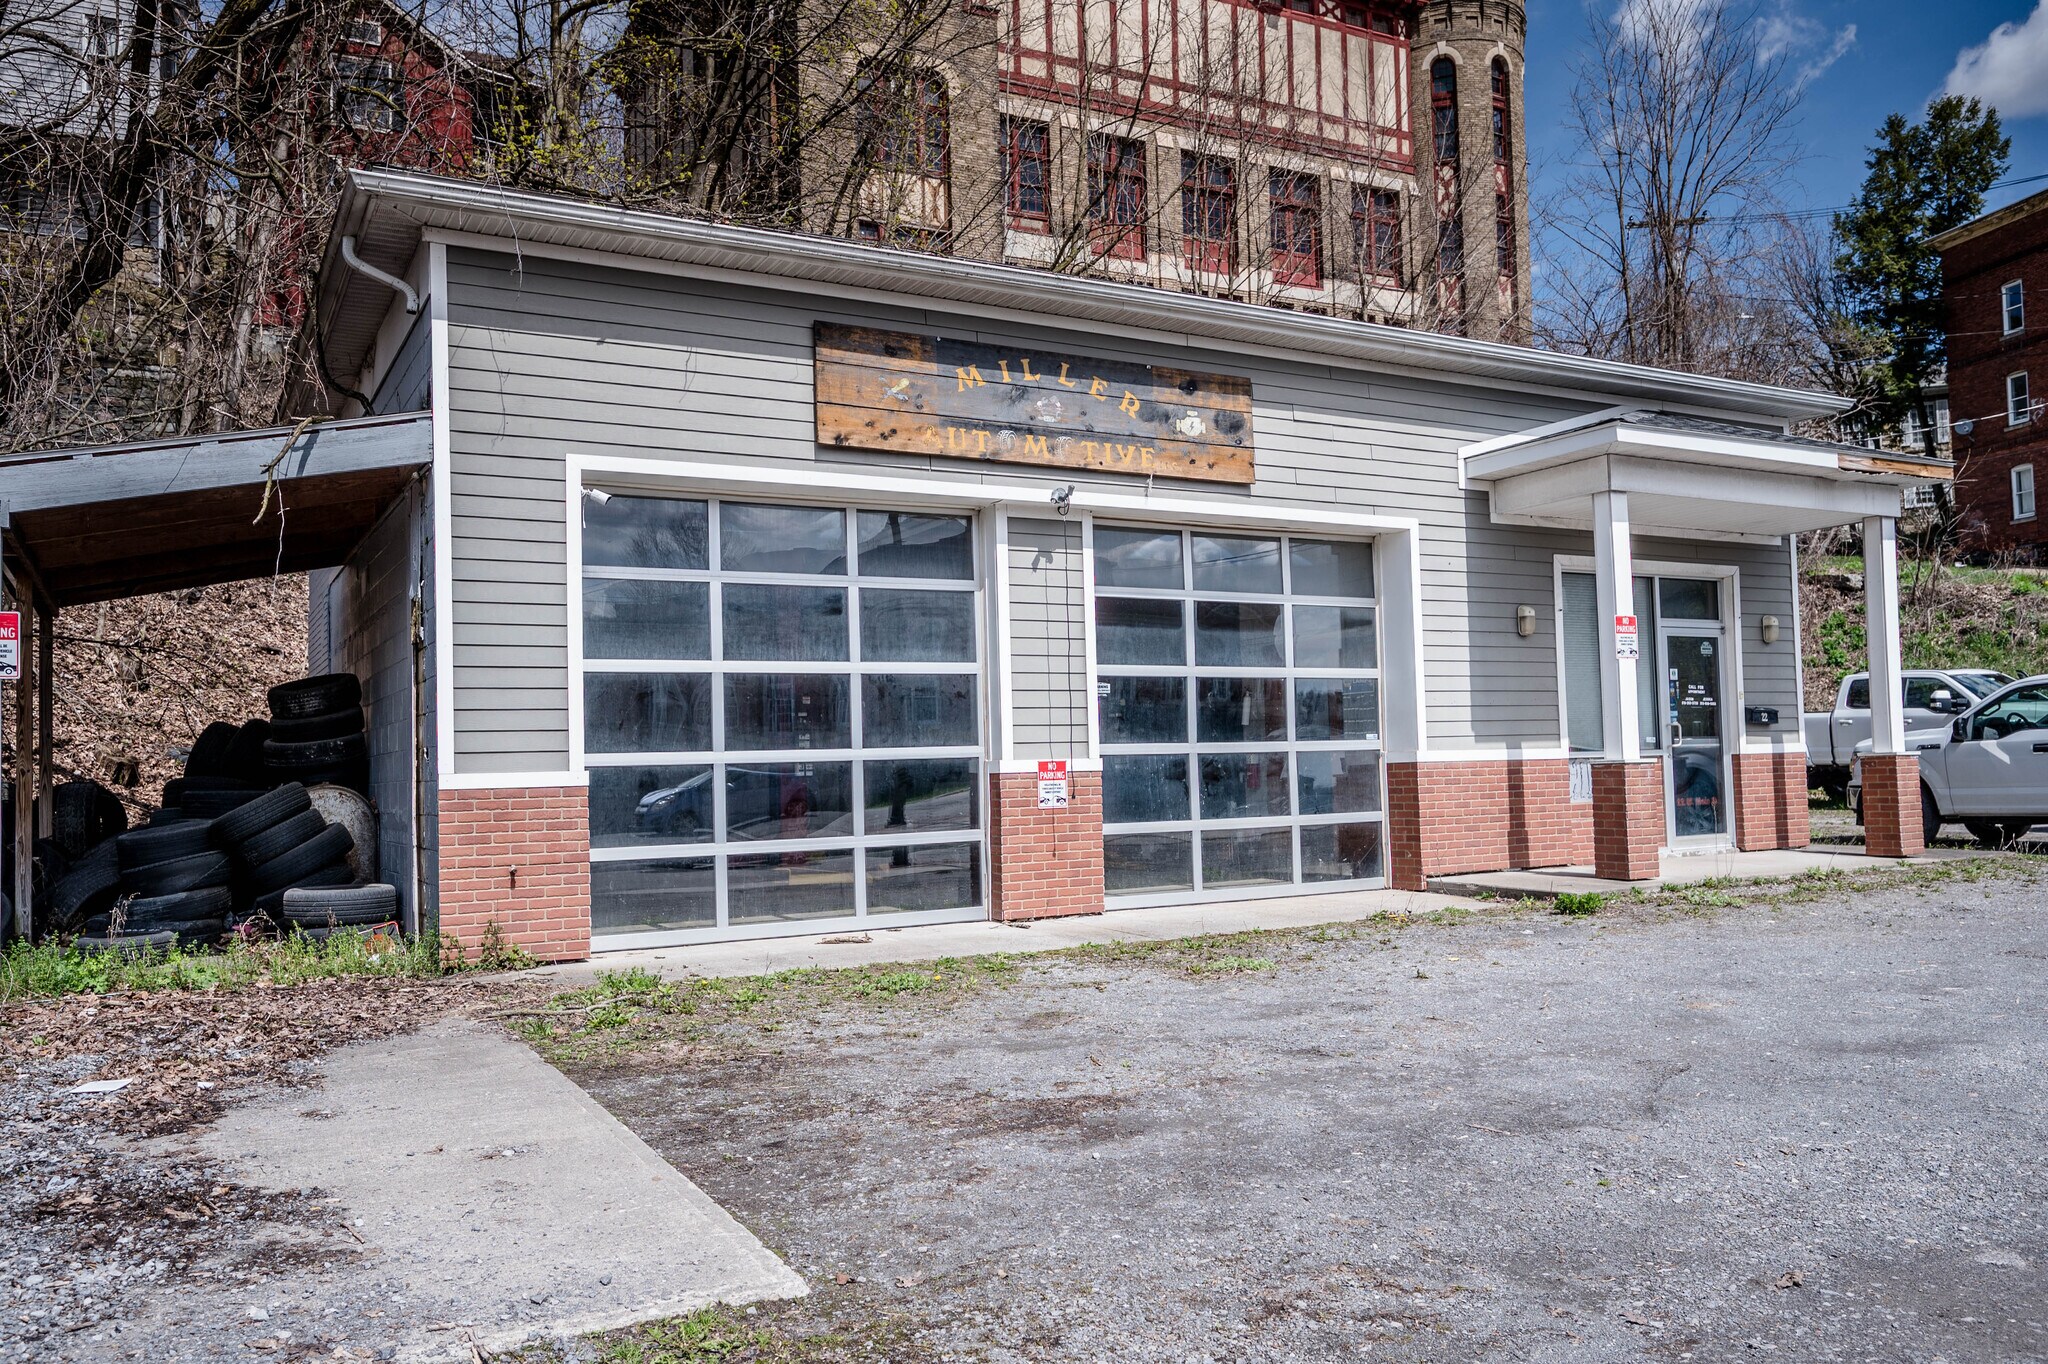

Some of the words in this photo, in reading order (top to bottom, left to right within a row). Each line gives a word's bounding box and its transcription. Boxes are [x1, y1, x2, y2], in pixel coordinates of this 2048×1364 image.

[955, 358, 1141, 419] MILLER
[1622, 617, 1630, 625] NO
[1616, 625, 1636, 633] PARKING
[1760, 712, 1769, 722] 22
[1047, 762, 1057, 771] NO
[1040, 771, 1066, 780] PARKING
